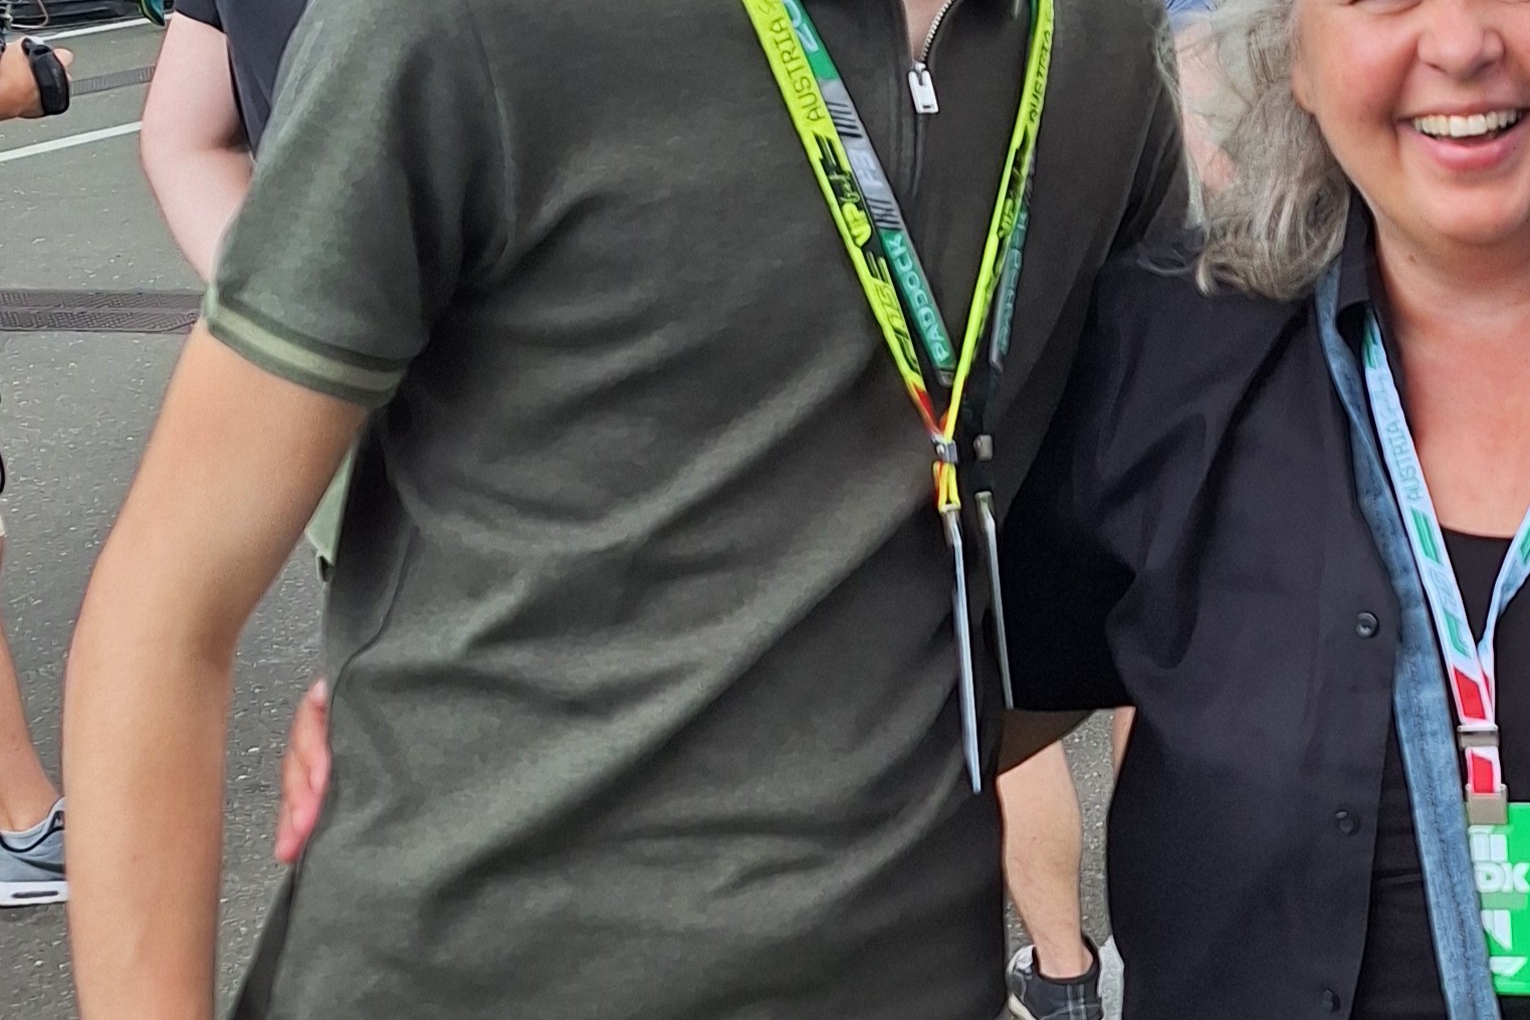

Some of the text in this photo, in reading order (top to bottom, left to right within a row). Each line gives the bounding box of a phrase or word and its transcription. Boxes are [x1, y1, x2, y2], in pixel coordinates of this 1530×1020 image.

[769, 18, 826, 122] AUSTRIA
[888, 232, 950, 363] PADDOCK
[1385, 421, 1423, 502] AUSTRIA
